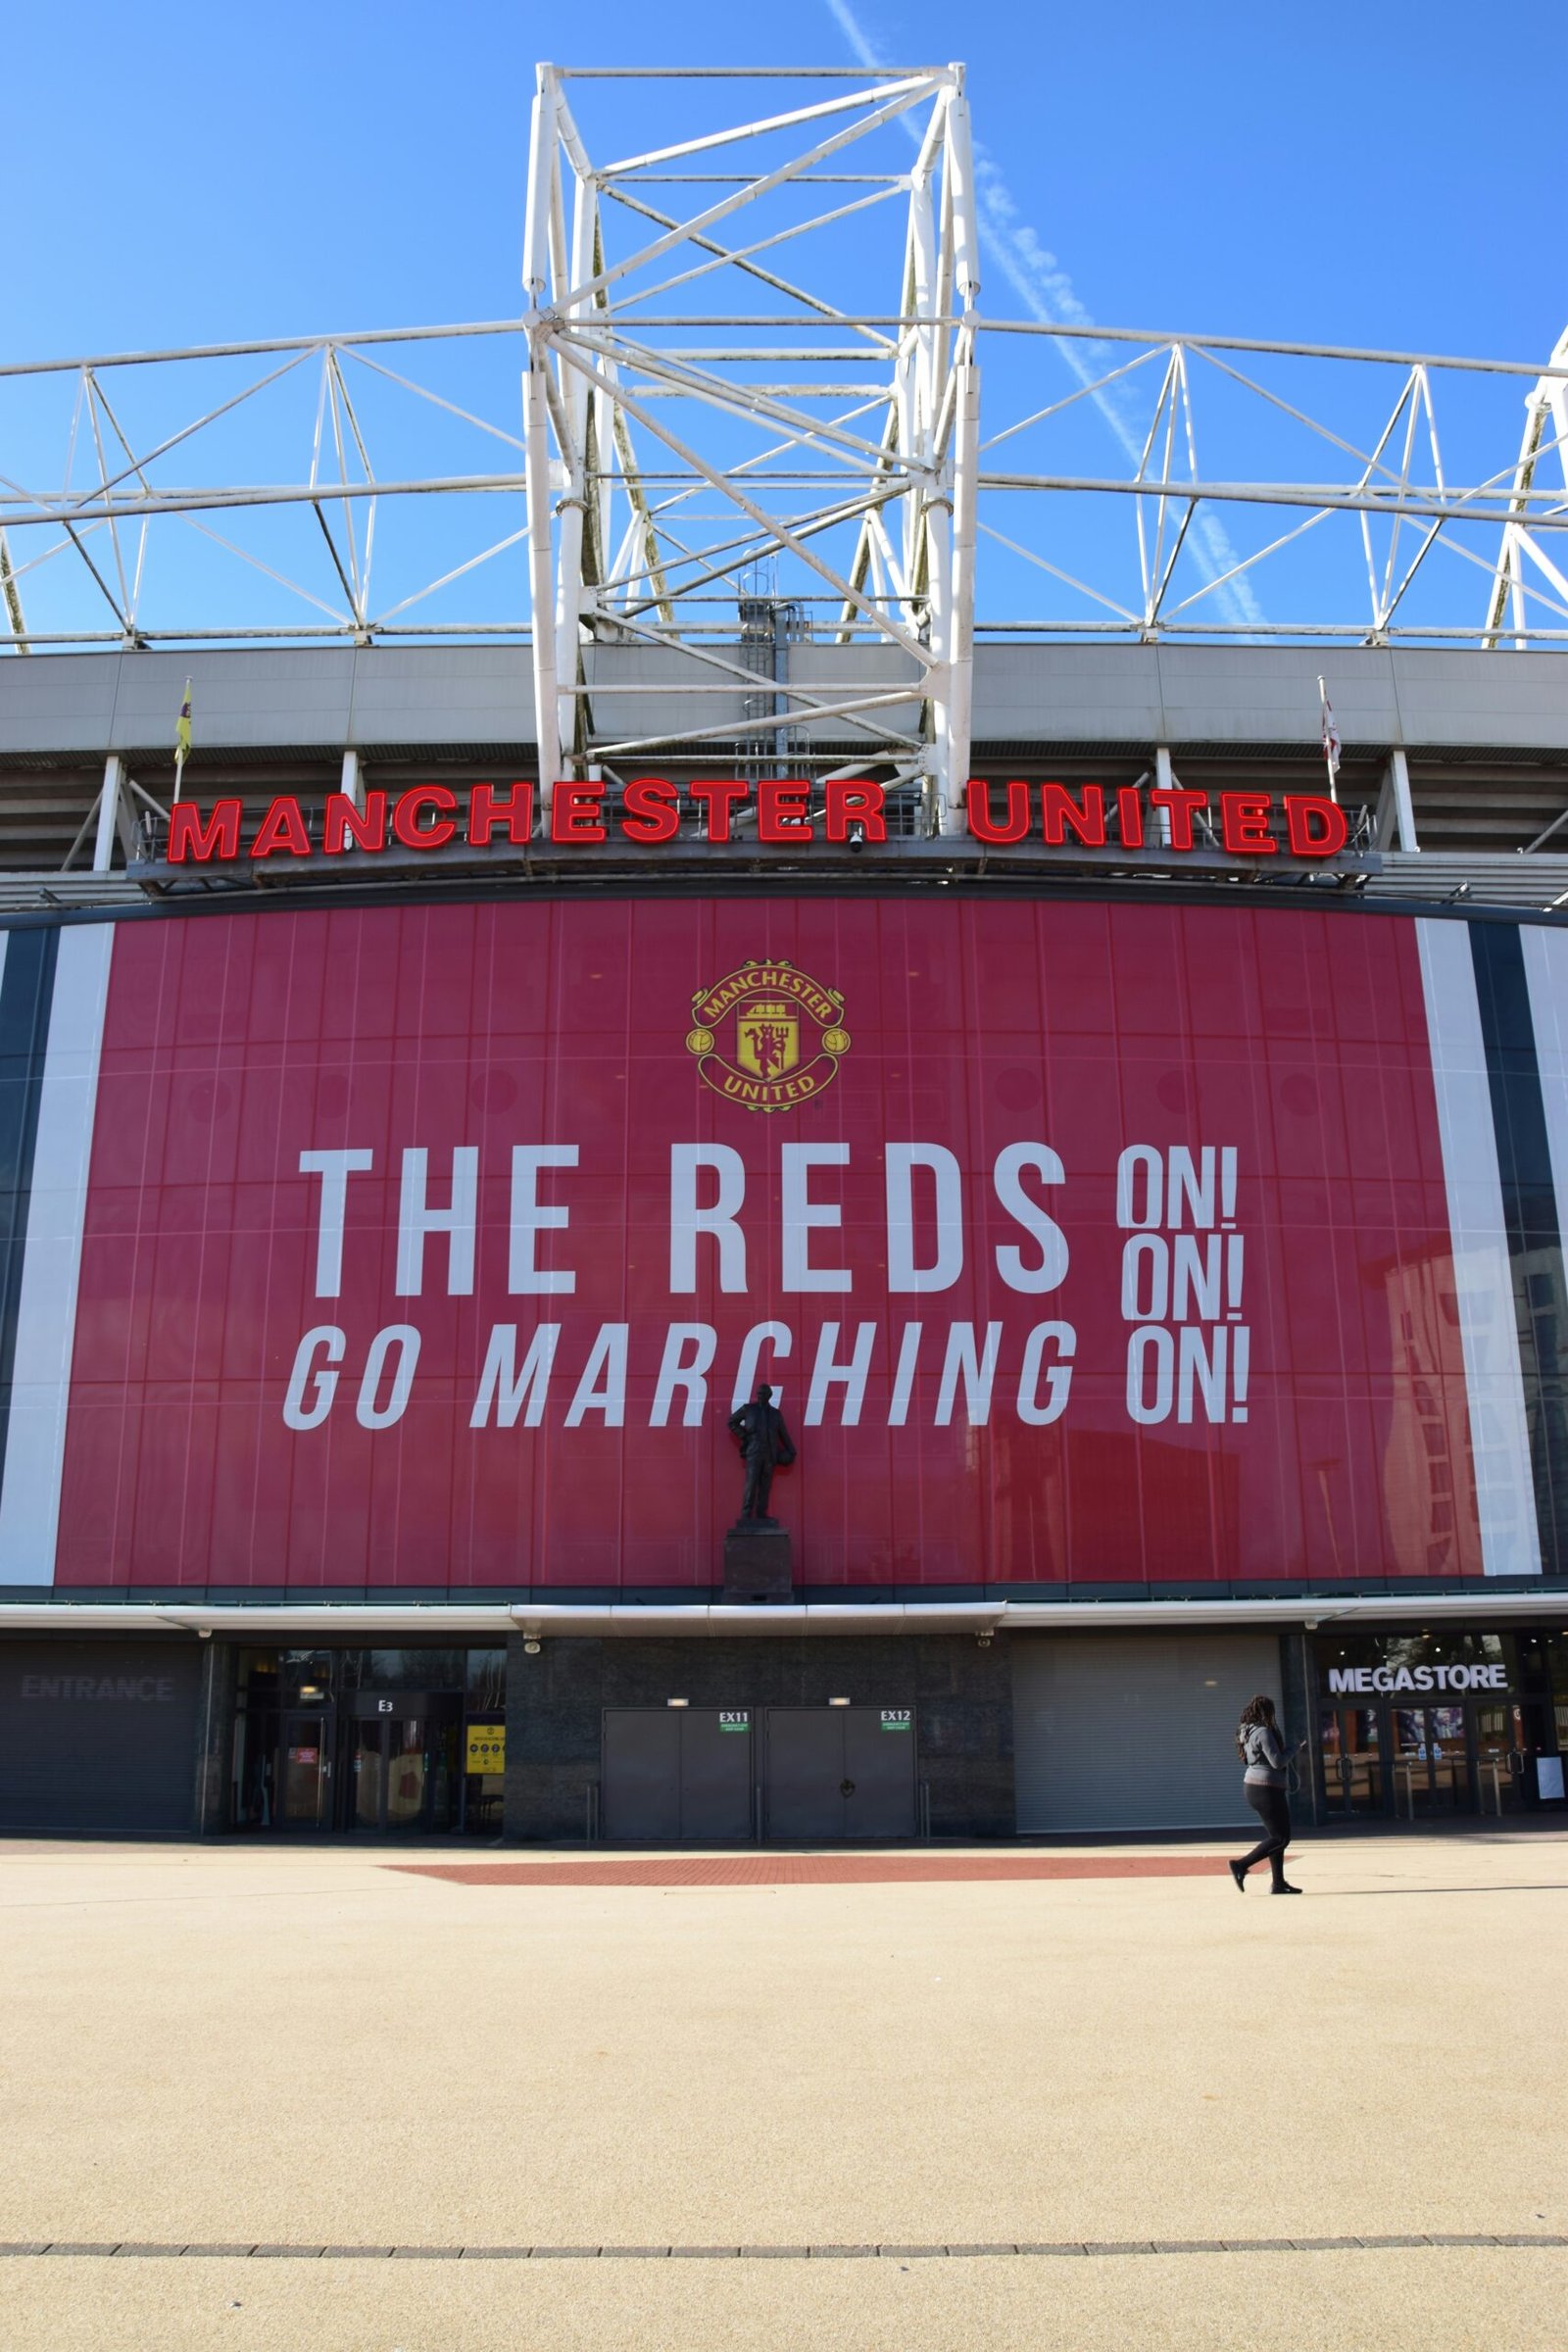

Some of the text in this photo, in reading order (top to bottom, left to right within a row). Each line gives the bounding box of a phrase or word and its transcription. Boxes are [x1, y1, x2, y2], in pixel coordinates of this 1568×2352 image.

[166, 776, 1349, 864] MANCHESTER UNITED
[703, 970, 833, 1019] MANCHESTER
[723, 1075, 815, 1102] UNITED
[1116, 1144, 1238, 1229] ON!
[298, 1141, 1069, 1298] THE REDS
[1120, 1233, 1245, 1321] ON!
[282, 1320, 1077, 1431] GO MARCHING
[1126, 1325, 1250, 1425] ON!
[21, 1675, 175, 1701] ENTRANCE
[1328, 1664, 1509, 1693] MEGASTORE
[378, 1699, 393, 1712] E3
[718, 1711, 748, 1723] EX11
[880, 1710, 911, 1721] EX12
